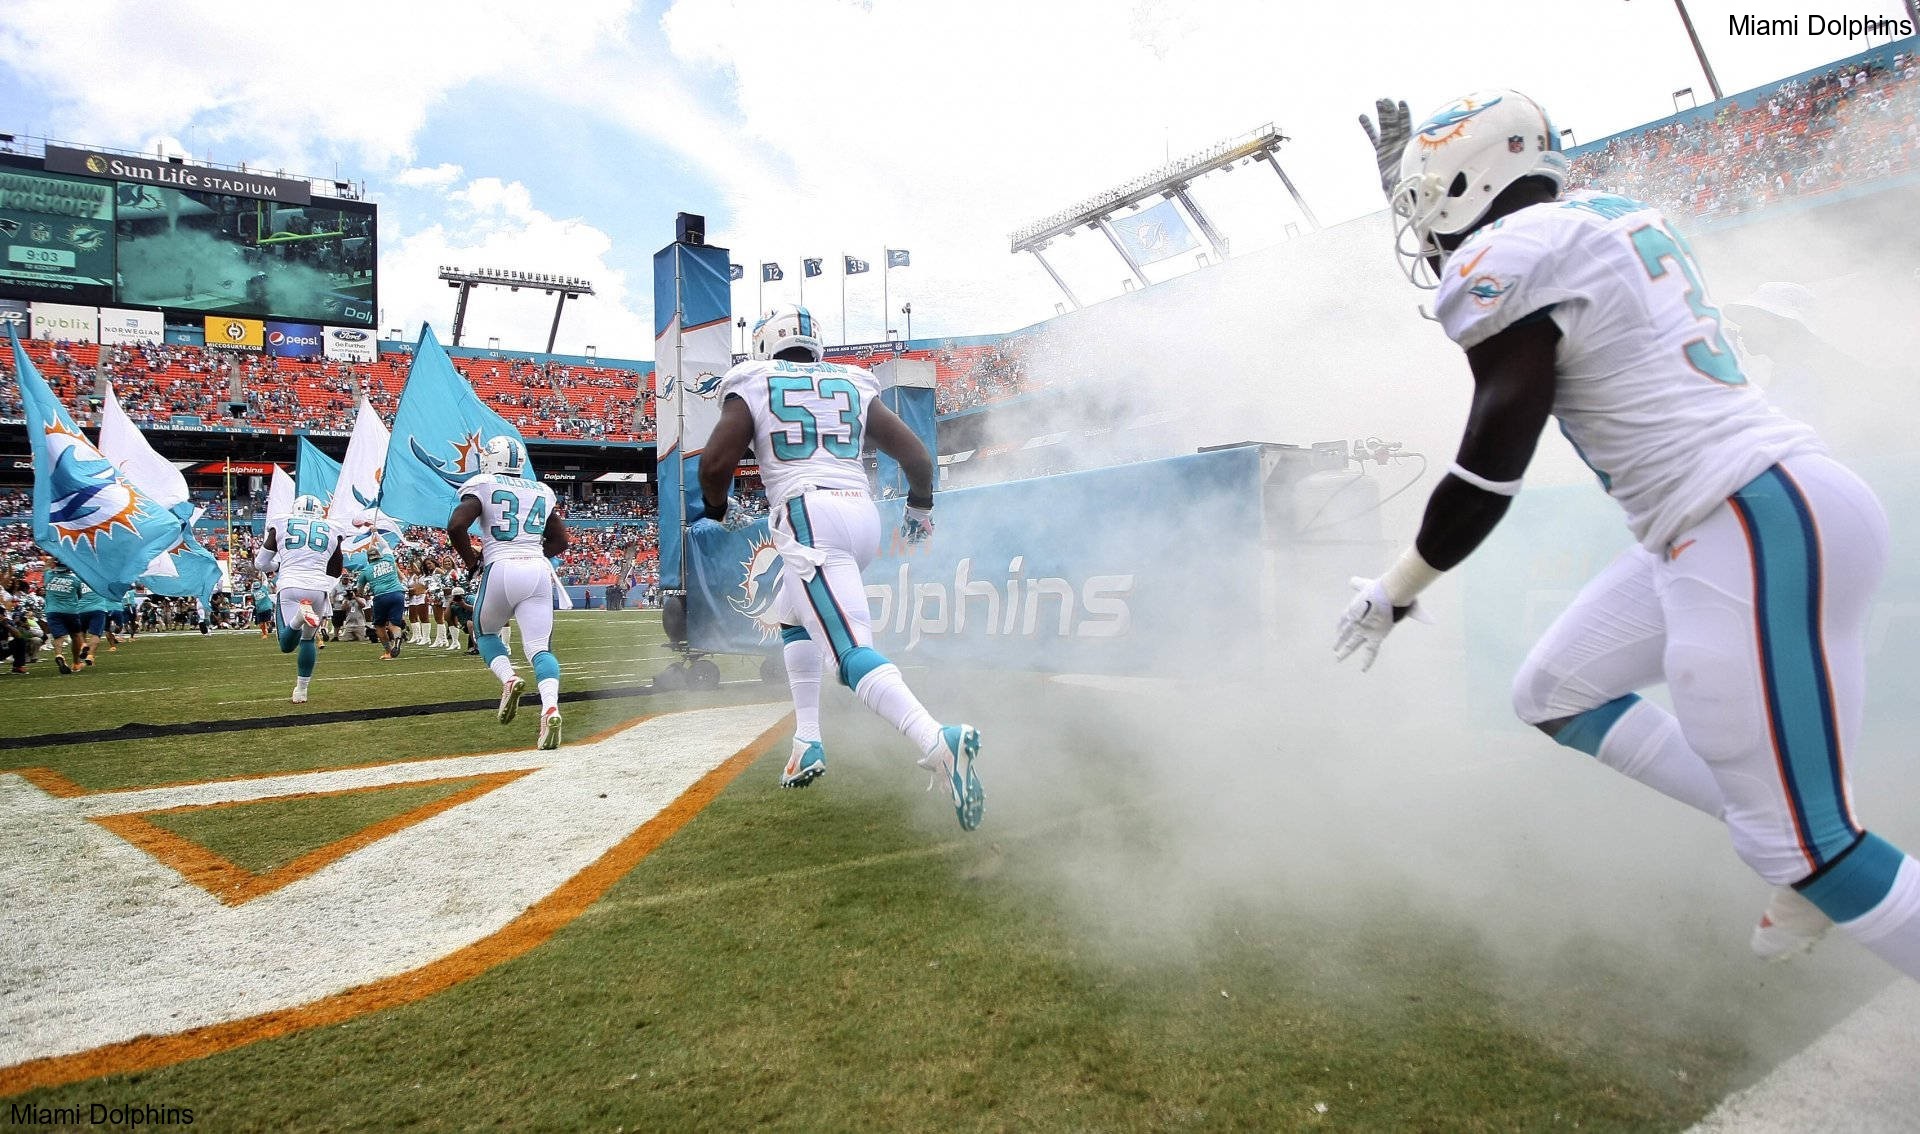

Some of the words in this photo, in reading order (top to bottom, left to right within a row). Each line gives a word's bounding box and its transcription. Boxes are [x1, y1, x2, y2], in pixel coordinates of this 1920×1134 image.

[111, 160, 153, 180] Sun
[158, 167, 198, 187] Life
[203, 177, 277, 197] STADIUM
[26, 249, 58, 263] 9:03
[850, 260, 865, 272] 39
[768, 268, 780, 280] 12
[1628, 217, 1749, 388] 3
[35, 315, 90, 330] Publix
[104, 326, 160, 336] NORWEGIAN
[339, 331, 362, 340] Ford
[286, 335, 318, 346] pepsi
[767, 376, 863, 461] 53
[543, 472, 576, 481] Dolphins
[830, 490, 863, 498] MIAMI
[491, 489, 547, 542] 34
[284, 518, 330, 553] 56
[864, 555, 1135, 651] olphins
